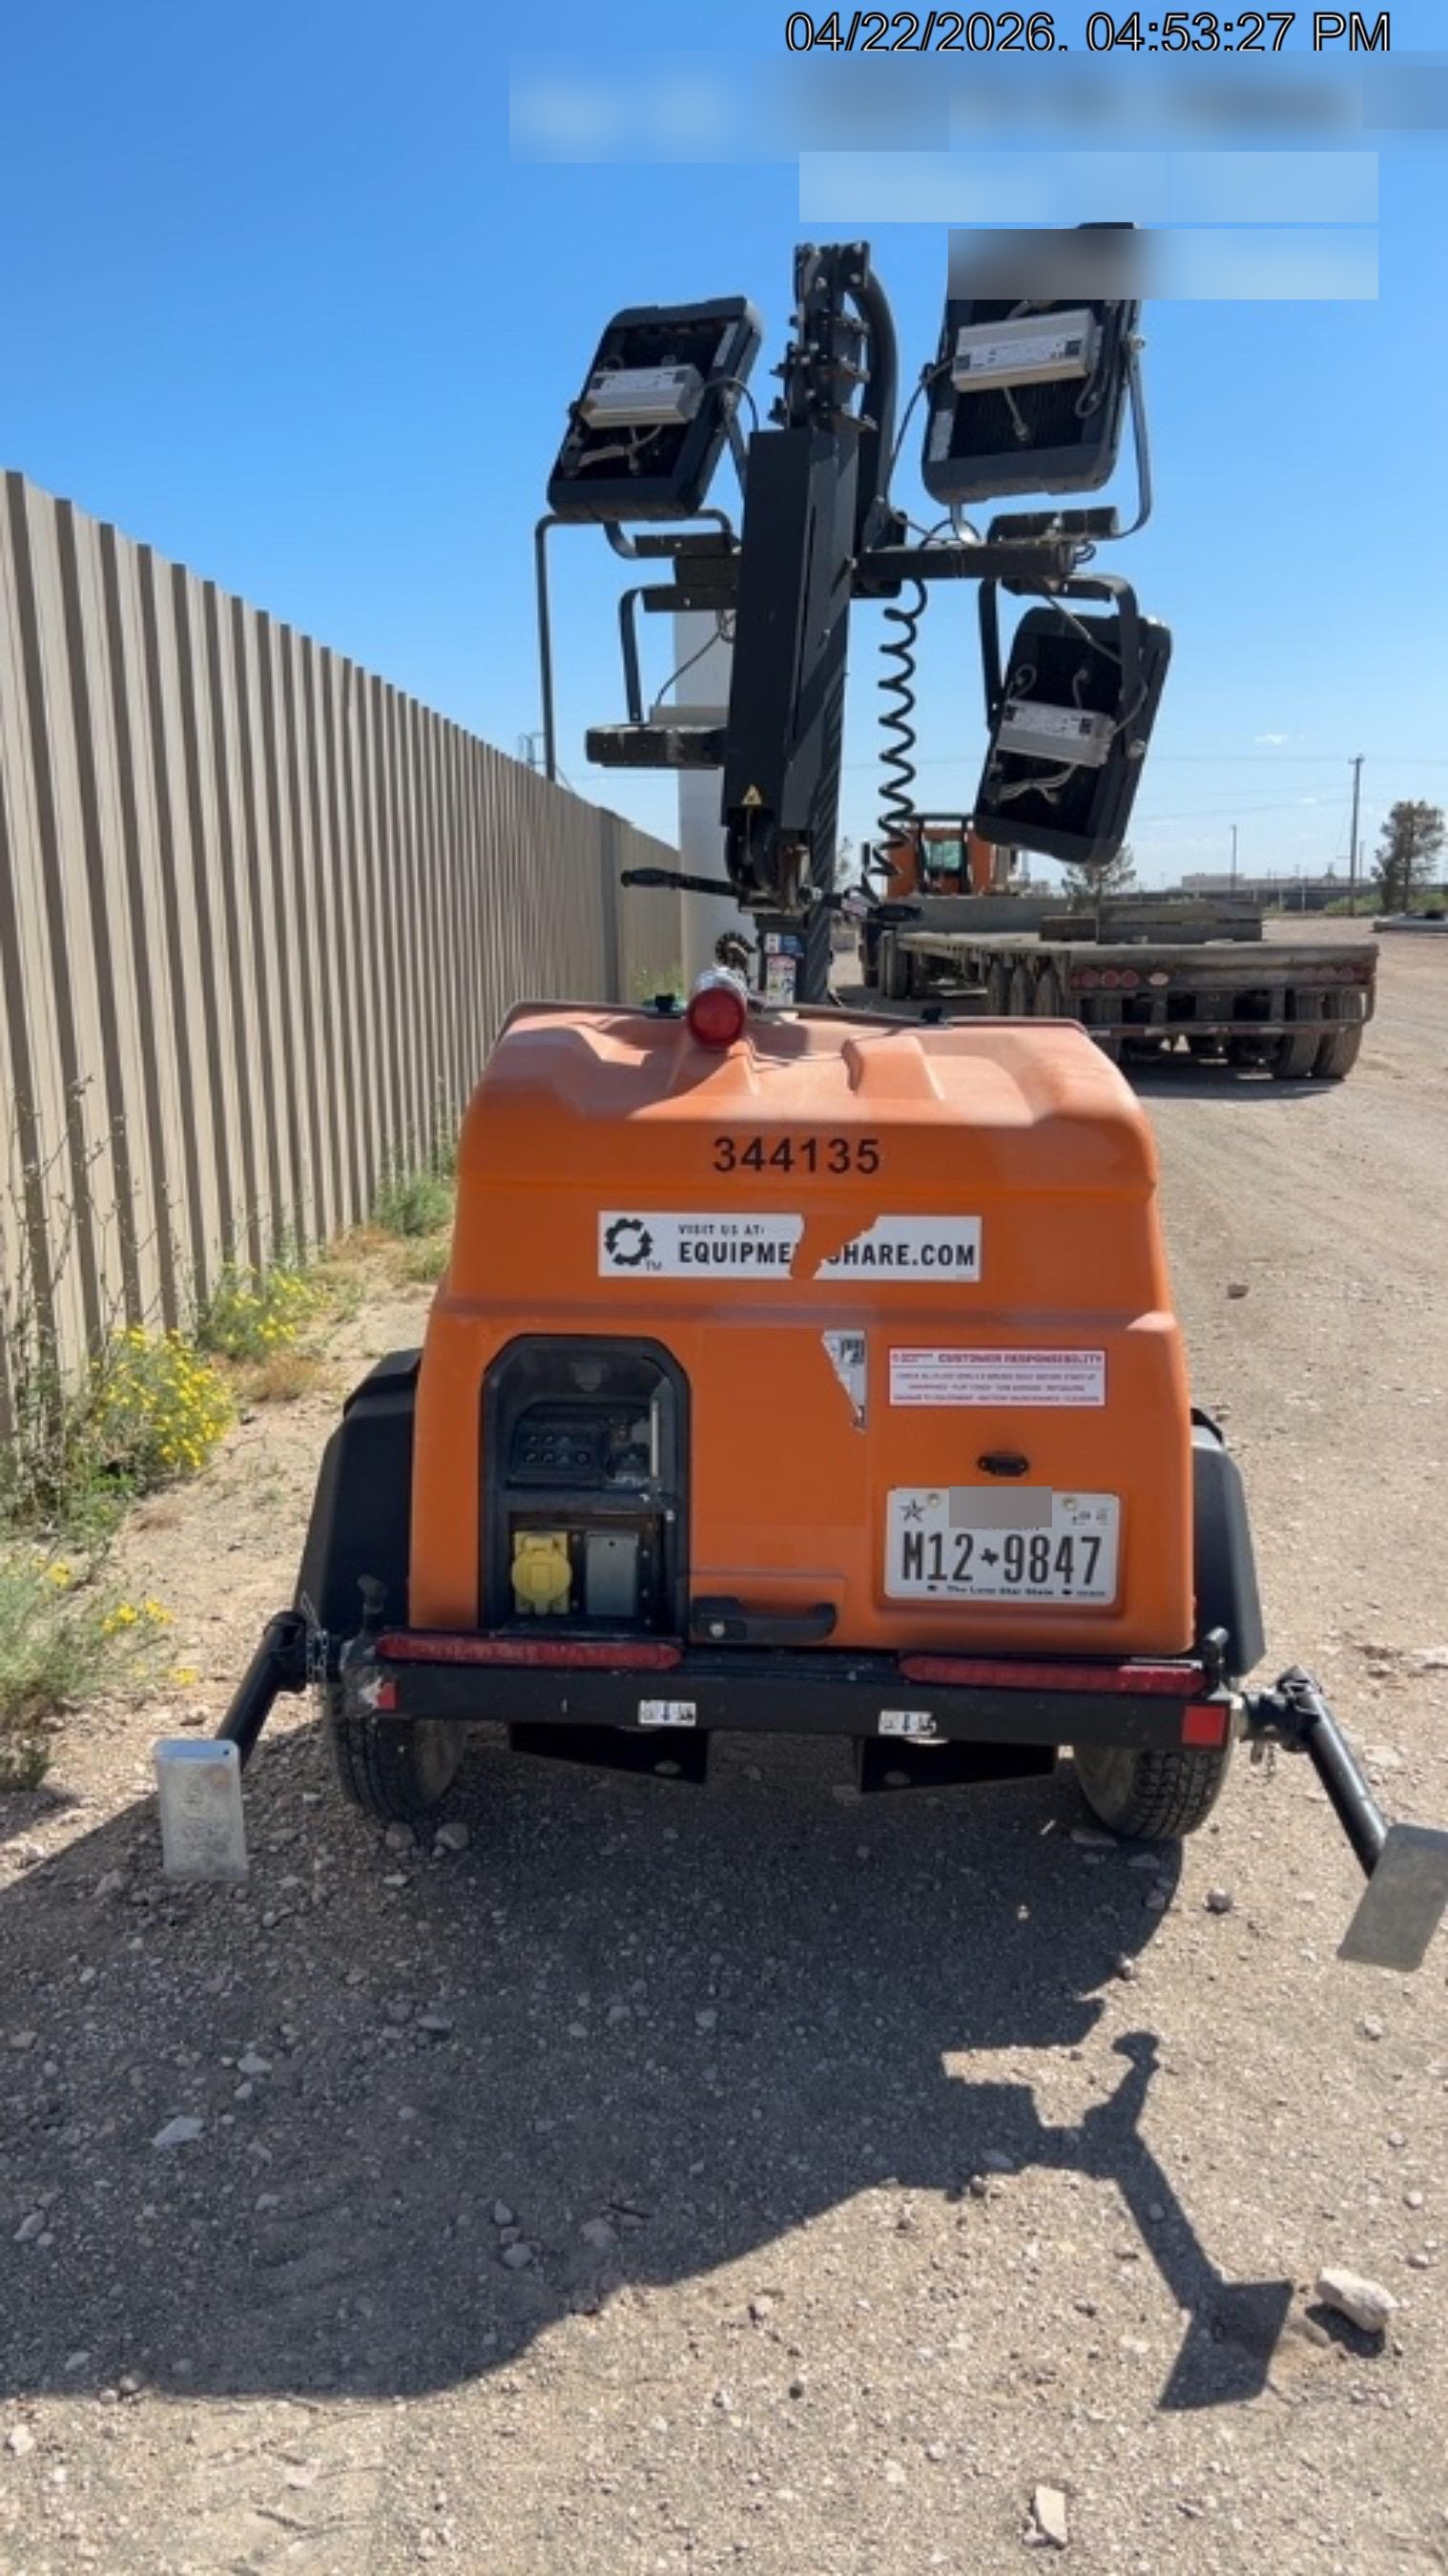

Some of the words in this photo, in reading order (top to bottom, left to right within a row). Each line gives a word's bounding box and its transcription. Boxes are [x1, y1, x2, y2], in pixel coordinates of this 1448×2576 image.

[713, 1135, 880, 1174] 344135
[678, 1224, 714, 1235] VISIT
[720, 1224, 737, 1236] US
[678, 1240, 975, 1267] EQUIPMEHARE.COM
[938, 1353, 1003, 1363] CUSTOMER
[1004, 1353, 1102, 1364] RESPONSIBILITY
